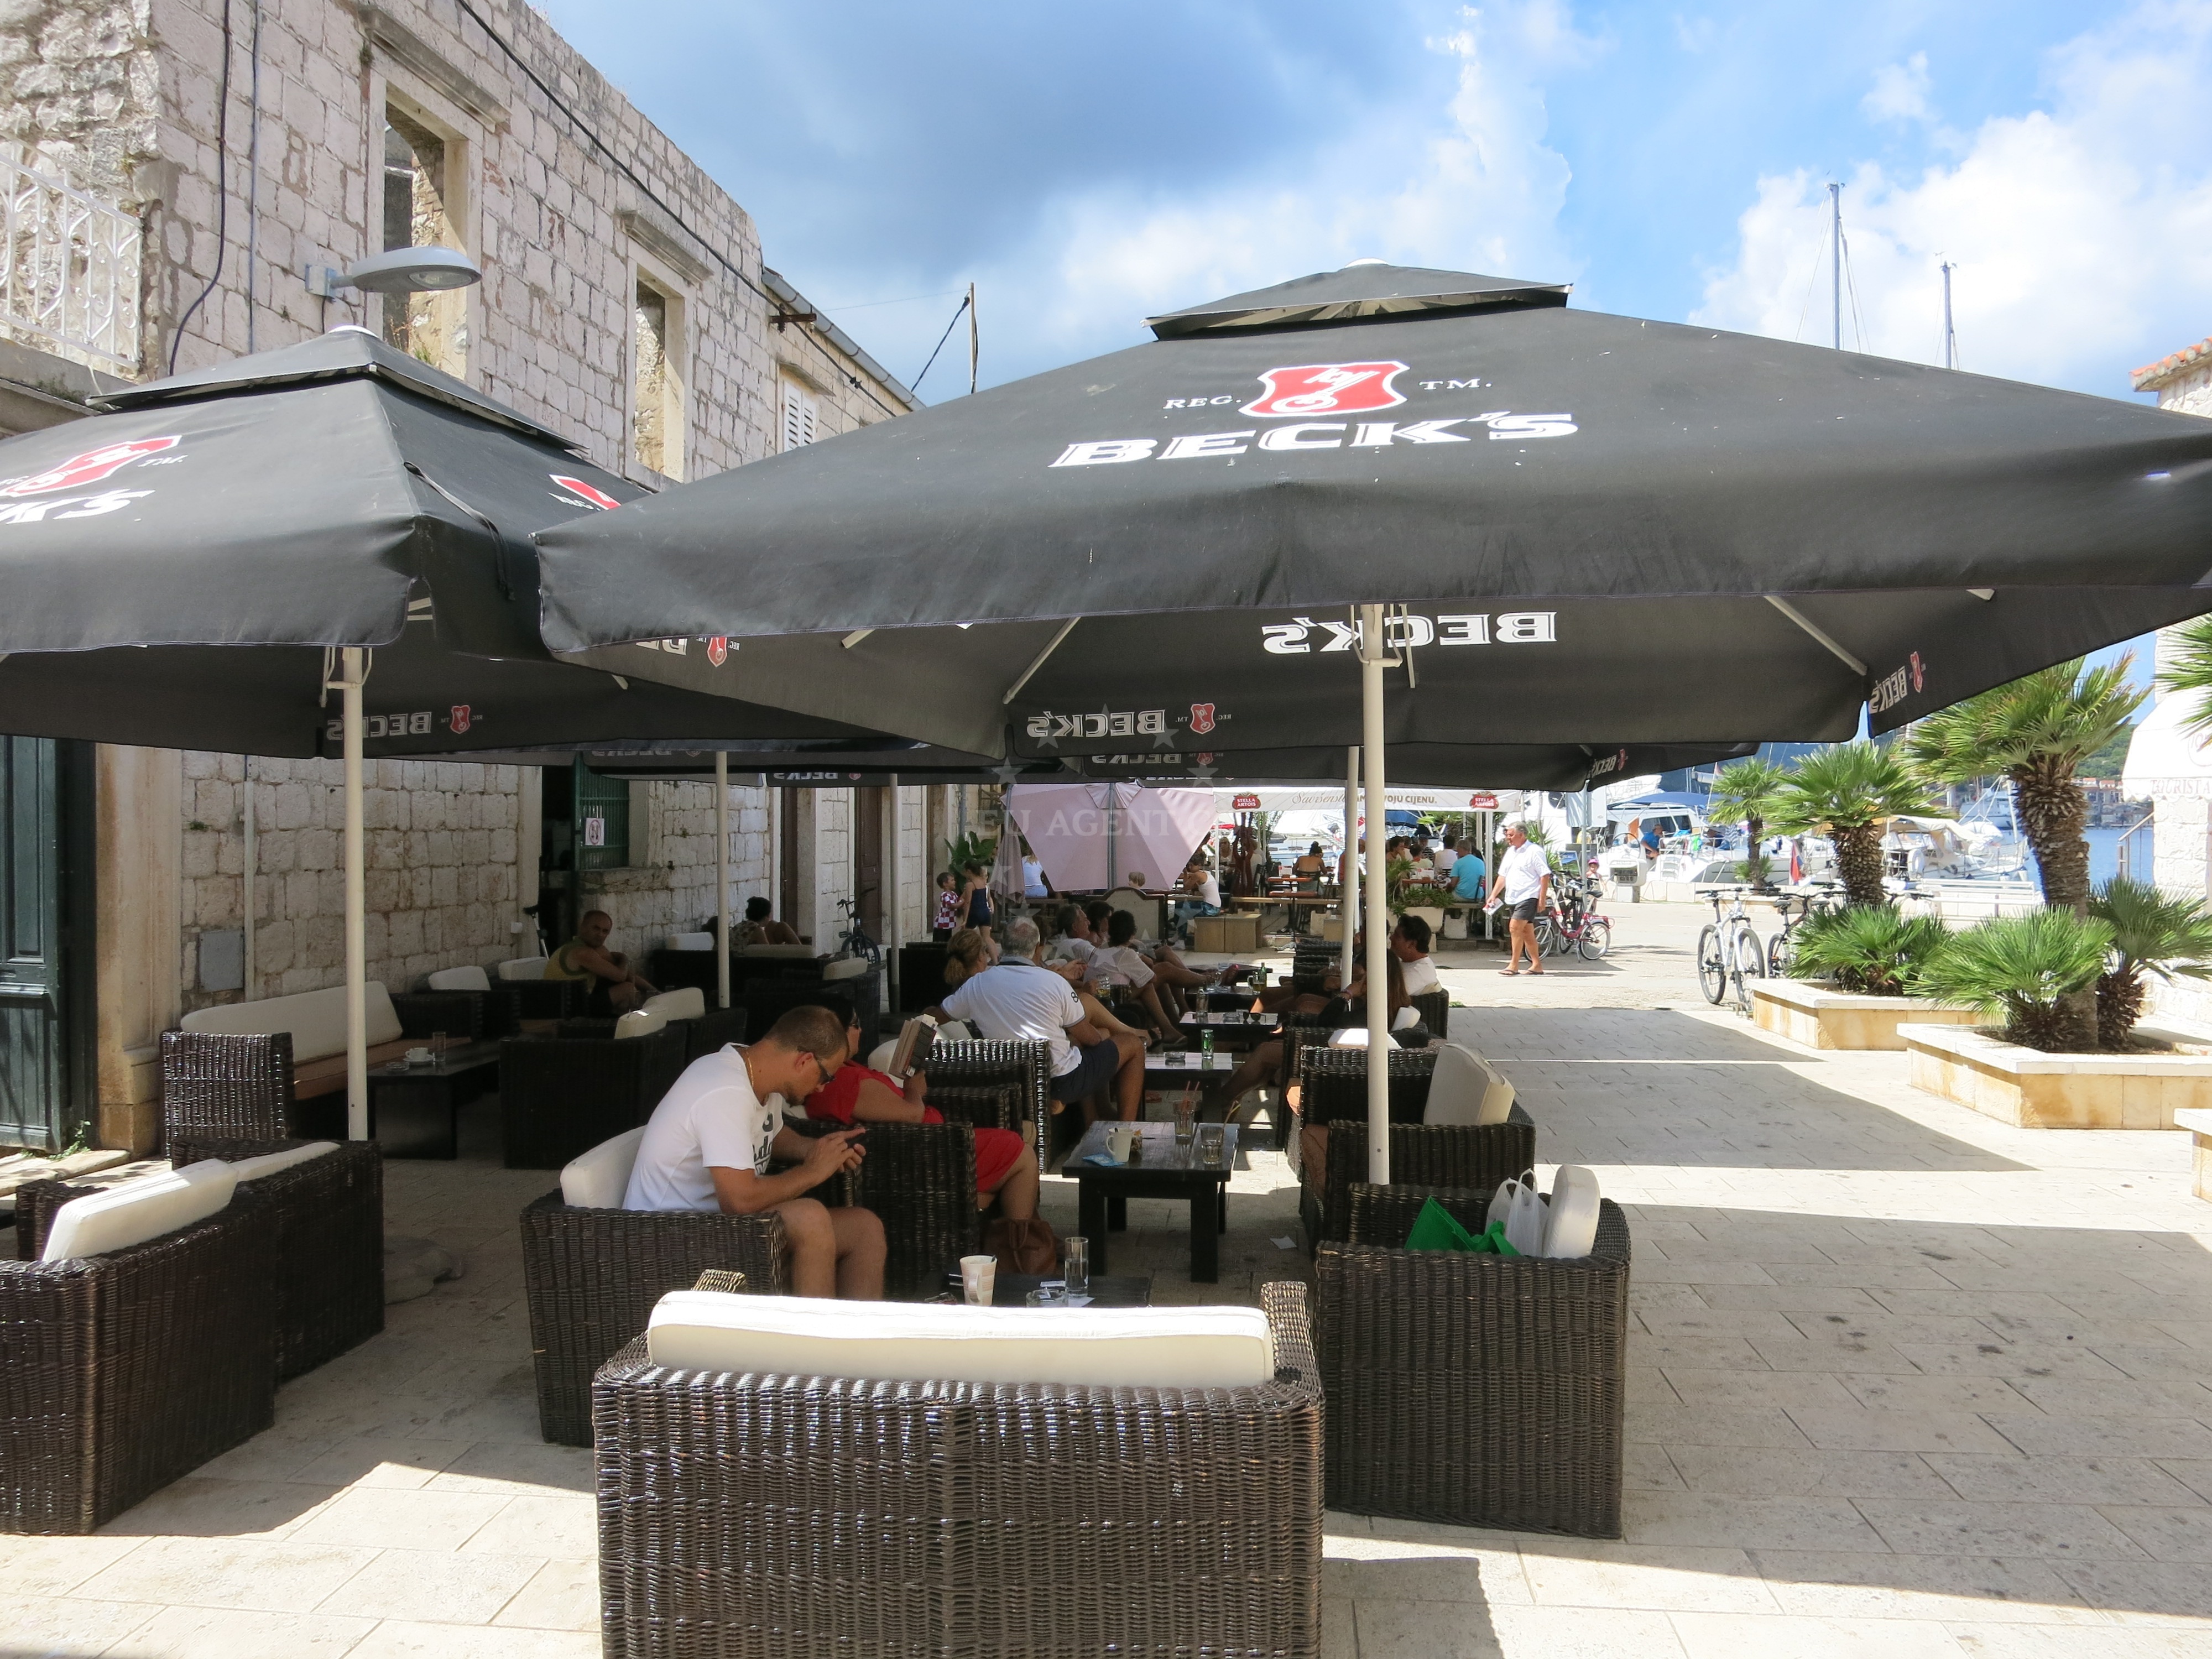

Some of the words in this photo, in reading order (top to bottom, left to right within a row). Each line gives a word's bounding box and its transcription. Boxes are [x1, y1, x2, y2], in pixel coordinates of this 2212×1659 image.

[1162, 395, 1242, 409] REG.
[1418, 380, 1493, 392] TM.
[1047, 411, 1579, 468] BECK'S
[2150, 779, 2201, 795] TOURIST
[1405, 795, 1438, 804] CIJENU.
